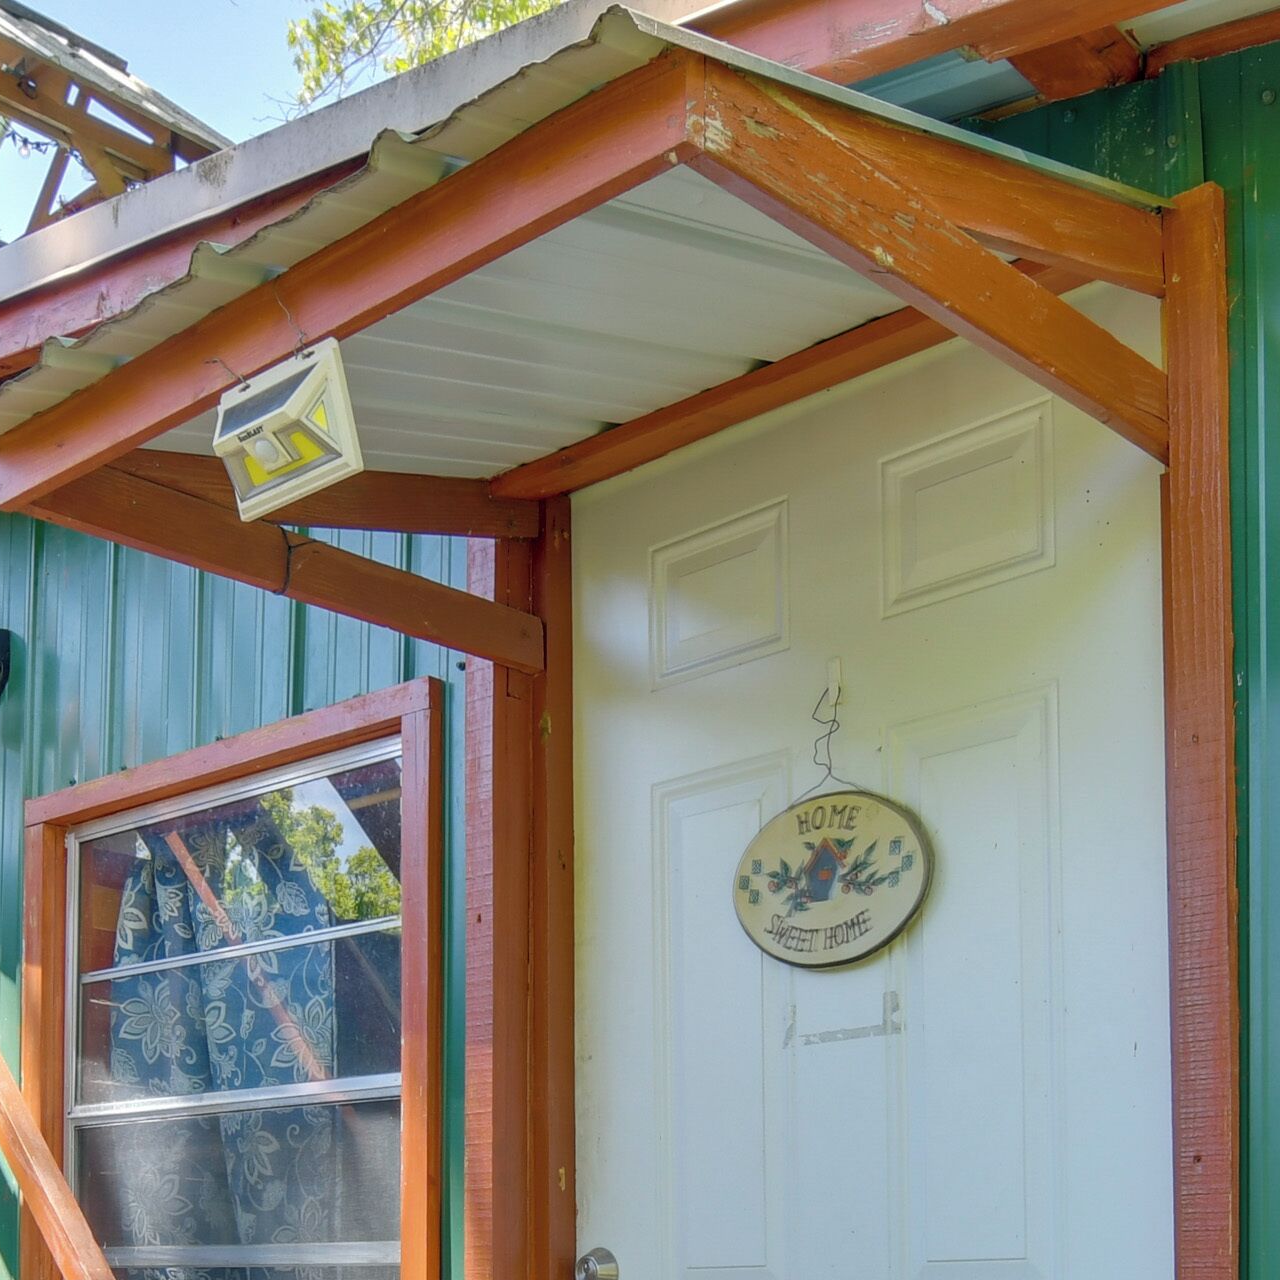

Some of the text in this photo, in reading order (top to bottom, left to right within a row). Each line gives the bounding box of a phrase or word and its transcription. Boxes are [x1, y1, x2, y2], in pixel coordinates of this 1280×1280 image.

[795, 804, 862, 836] HOME
[763, 908, 873, 953] SWEET HOME
